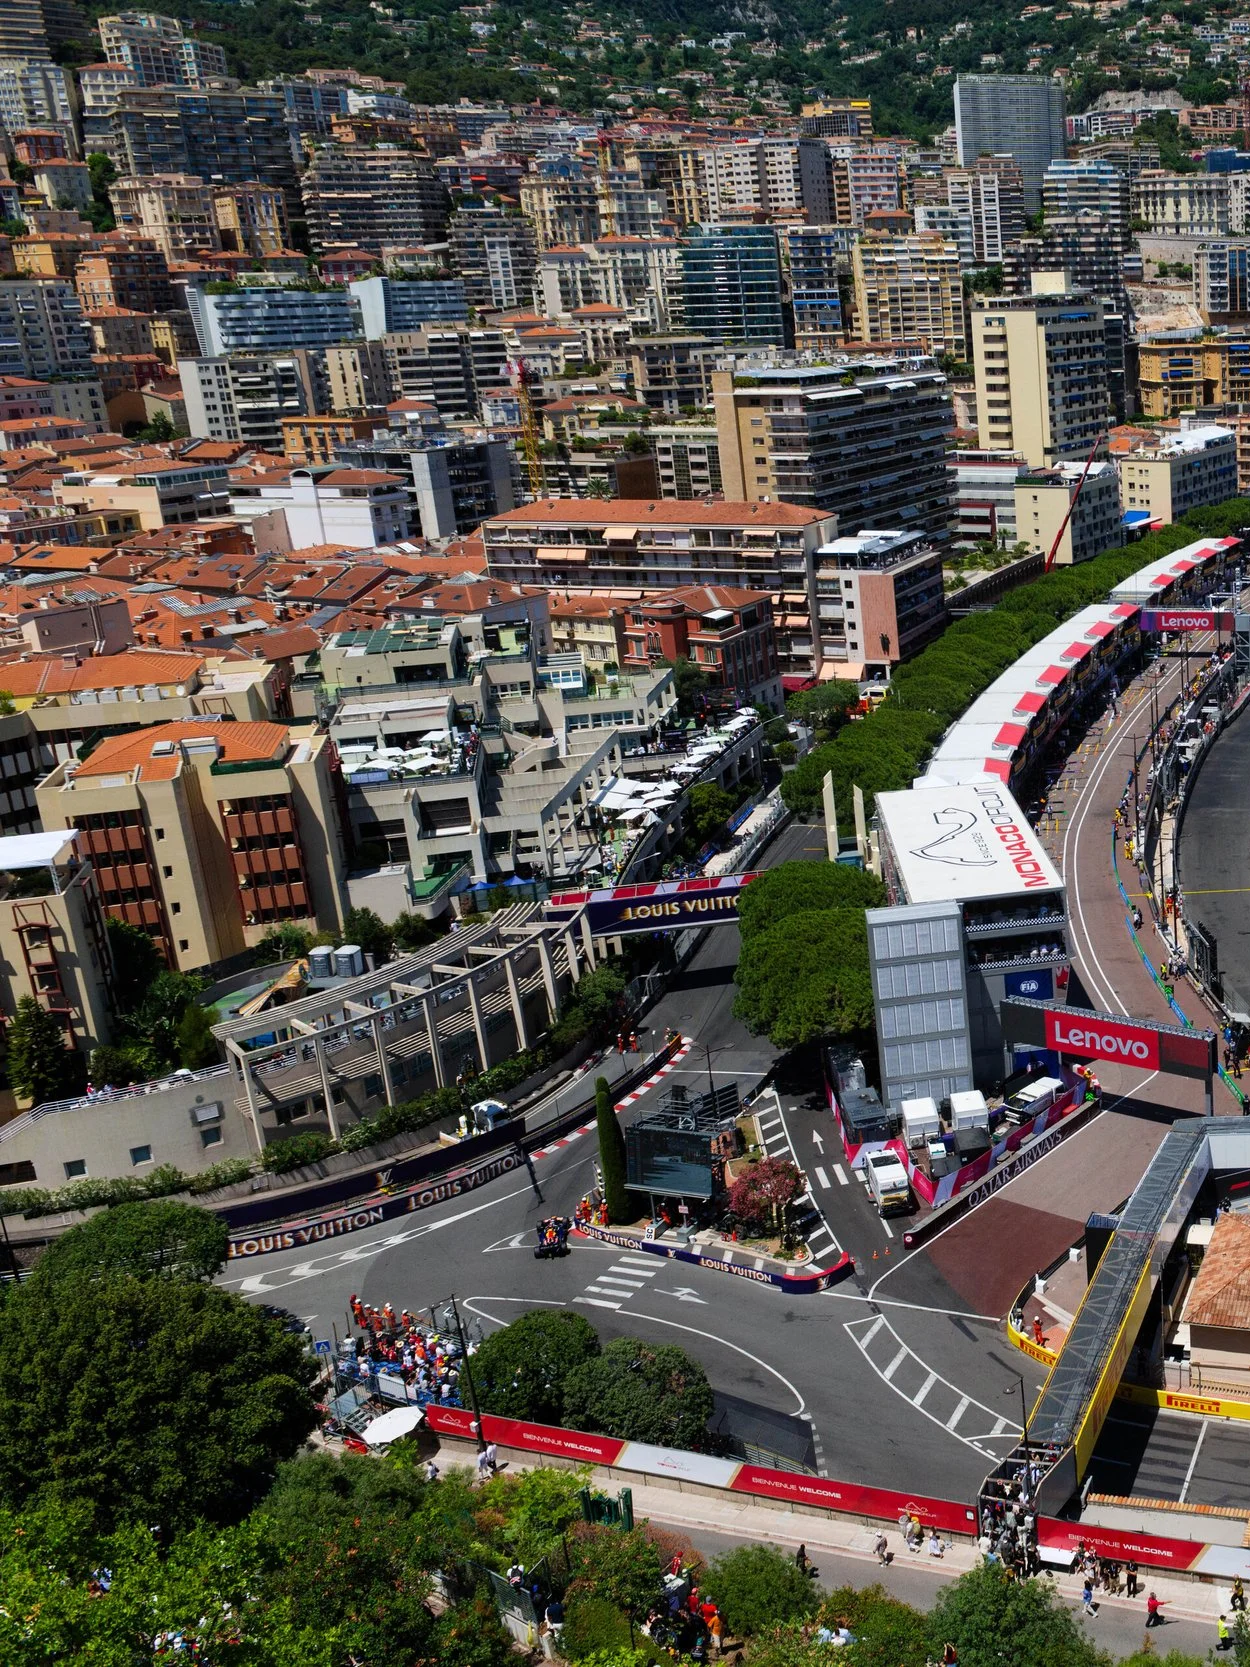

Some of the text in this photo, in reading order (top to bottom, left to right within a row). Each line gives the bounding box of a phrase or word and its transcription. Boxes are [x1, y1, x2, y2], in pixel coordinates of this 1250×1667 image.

[1161, 615, 1209, 627] Lenovo
[626, 902, 681, 920] LOUIS
[1021, 982, 1037, 991] FIA
[1054, 1020, 1149, 1059] Lenovo
[410, 1151, 527, 1211] LOUIS VUITTON
[968, 1129, 1063, 1207] QATAR AIRWAYS
[229, 1207, 384, 1258] LOUIS VUITTON
[578, 1223, 643, 1250] LOUIS VUITTON
[646, 1228, 653, 1240] SC
[701, 1257, 772, 1283] LOUIS VUITTON
[1020, 1338, 1056, 1366] PIRELL
[1166, 1394, 1220, 1412] PIRELLI
[522, 1432, 602, 1454] BIENVENUE WELCOME
[752, 1476, 842, 1499] BIENVENUE WELCOME
[1068, 1532, 1174, 1558] BIENVENUE WELCOME
